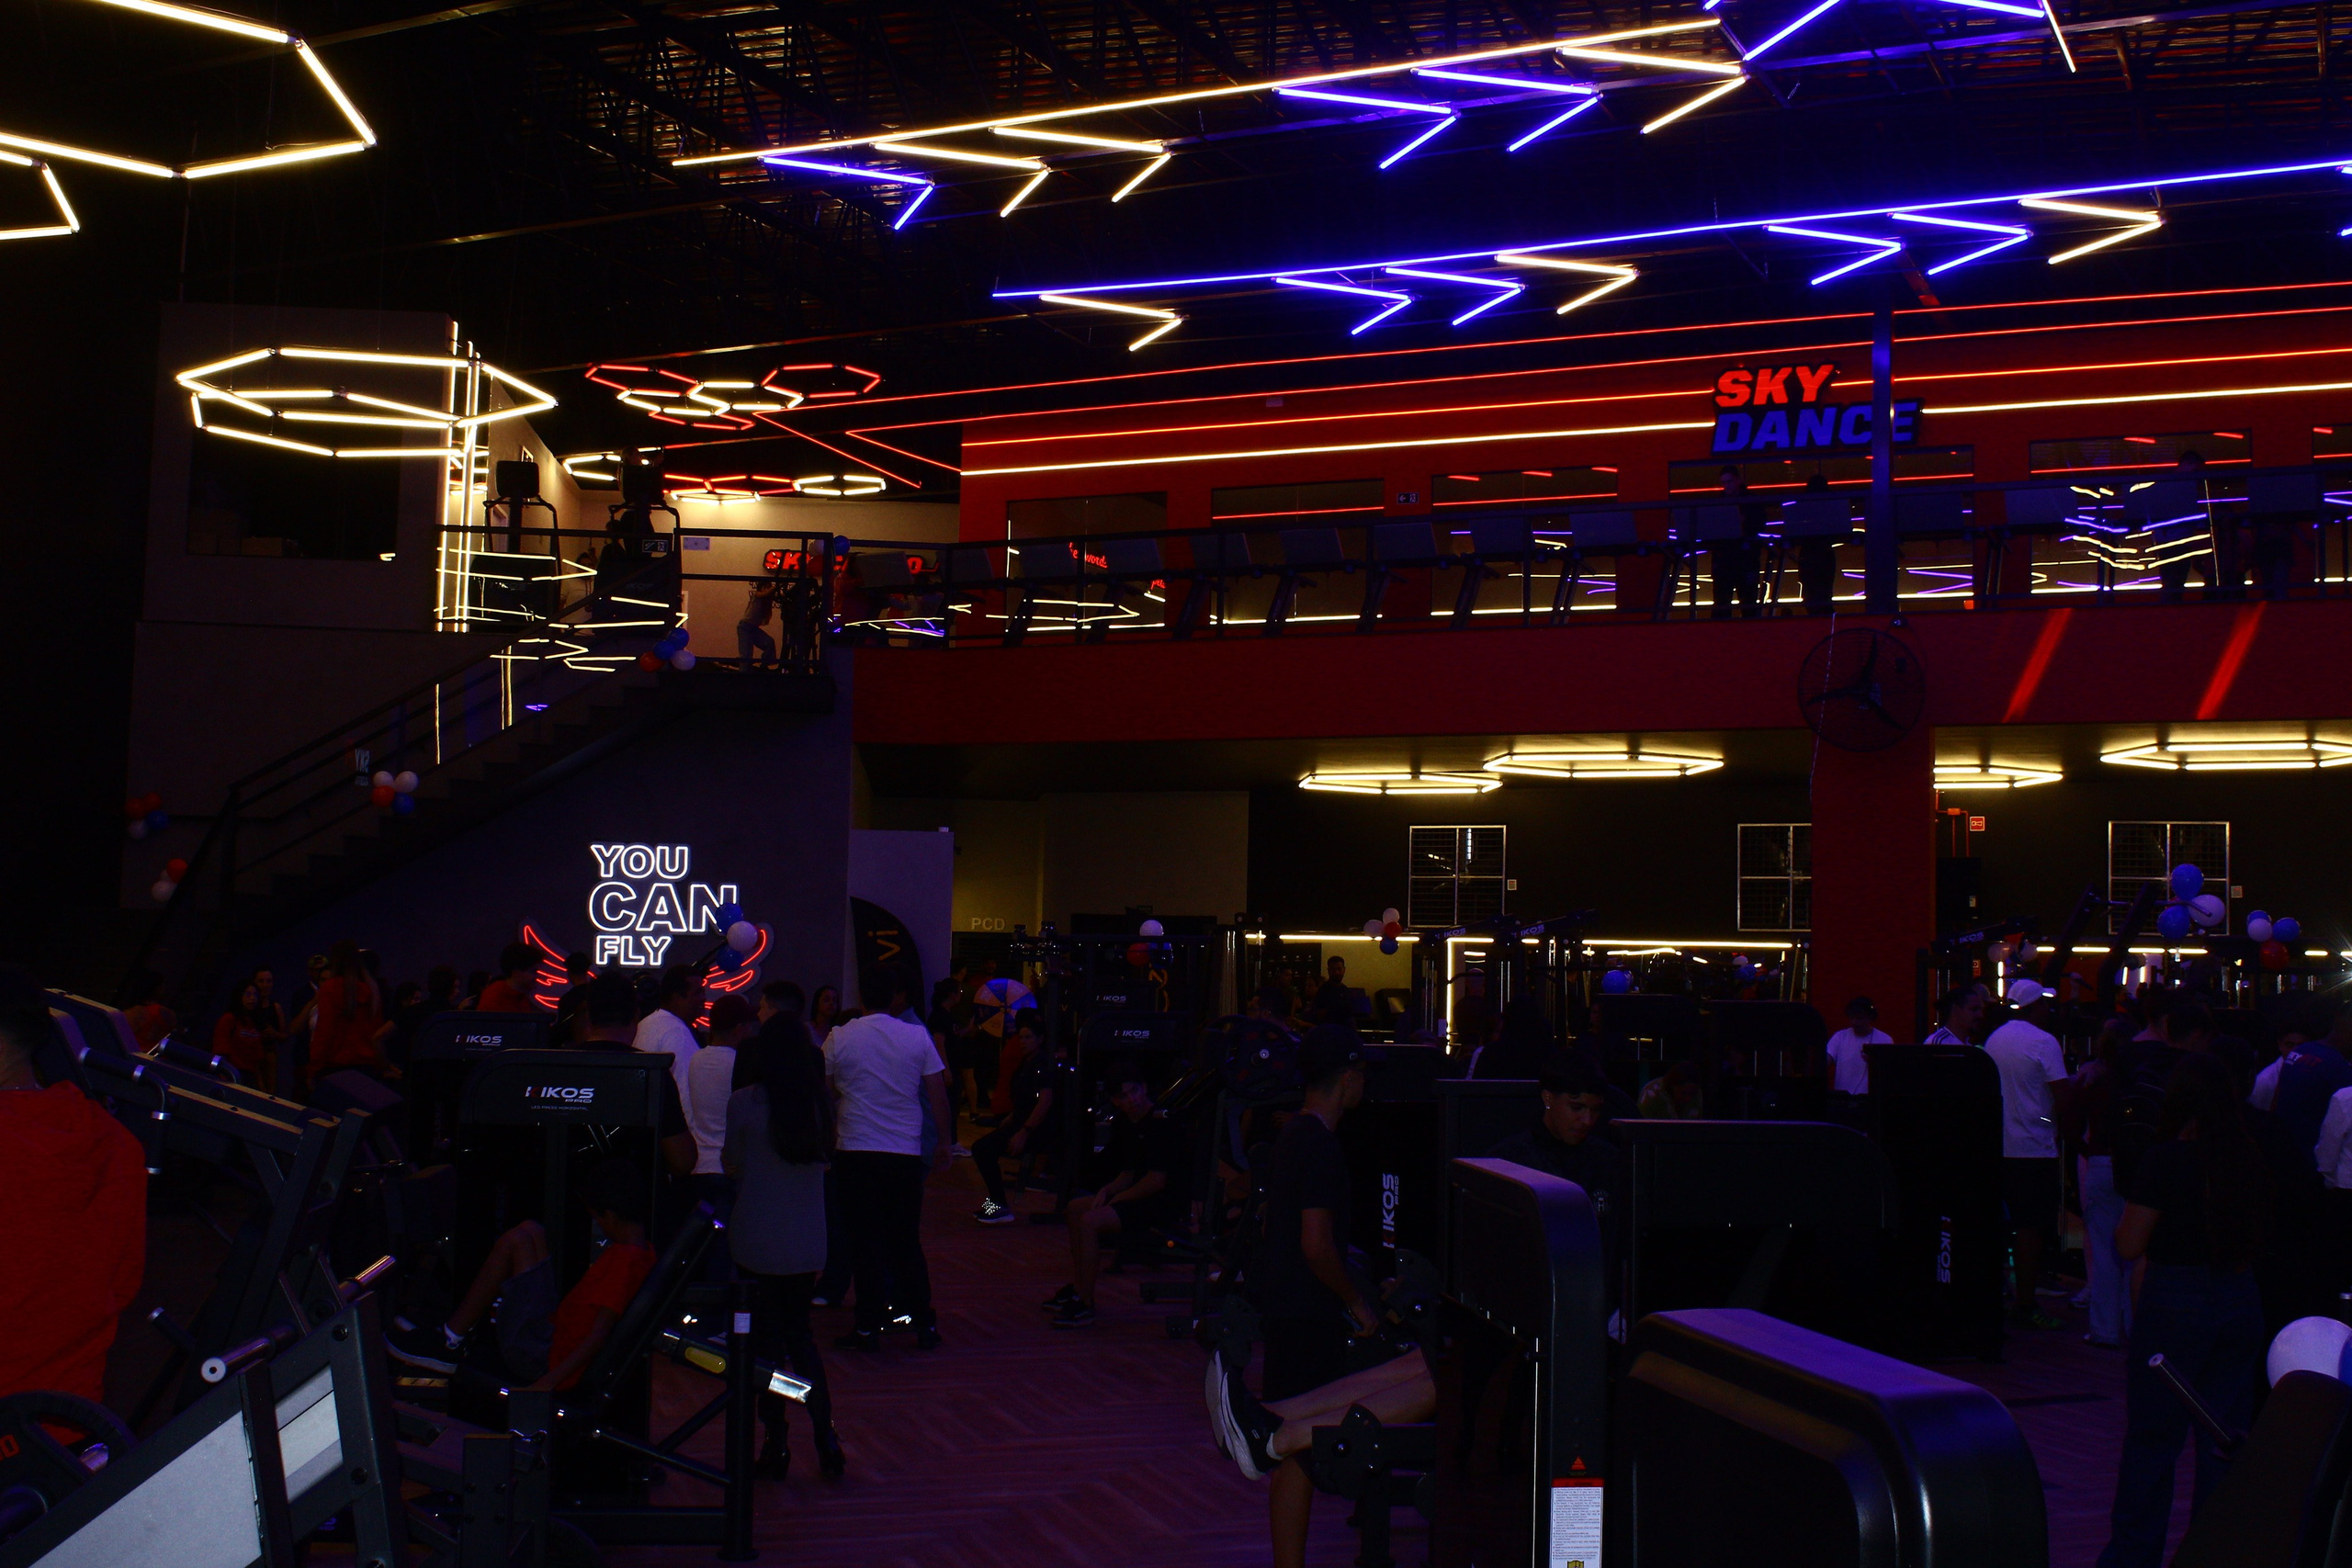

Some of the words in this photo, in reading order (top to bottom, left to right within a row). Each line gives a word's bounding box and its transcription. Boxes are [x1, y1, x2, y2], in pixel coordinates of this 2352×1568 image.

[1714, 364, 1834, 407] SKY
[1712, 400, 1918, 453] DANCE
[590, 844, 689, 880] YOU
[588, 881, 739, 932] CAN
[971, 917, 1005, 931] PCD
[595, 935, 672, 966] FLY
[524, 1086, 595, 1100] KIKOS
[1382, 1172, 1396, 1249] KIKOS
